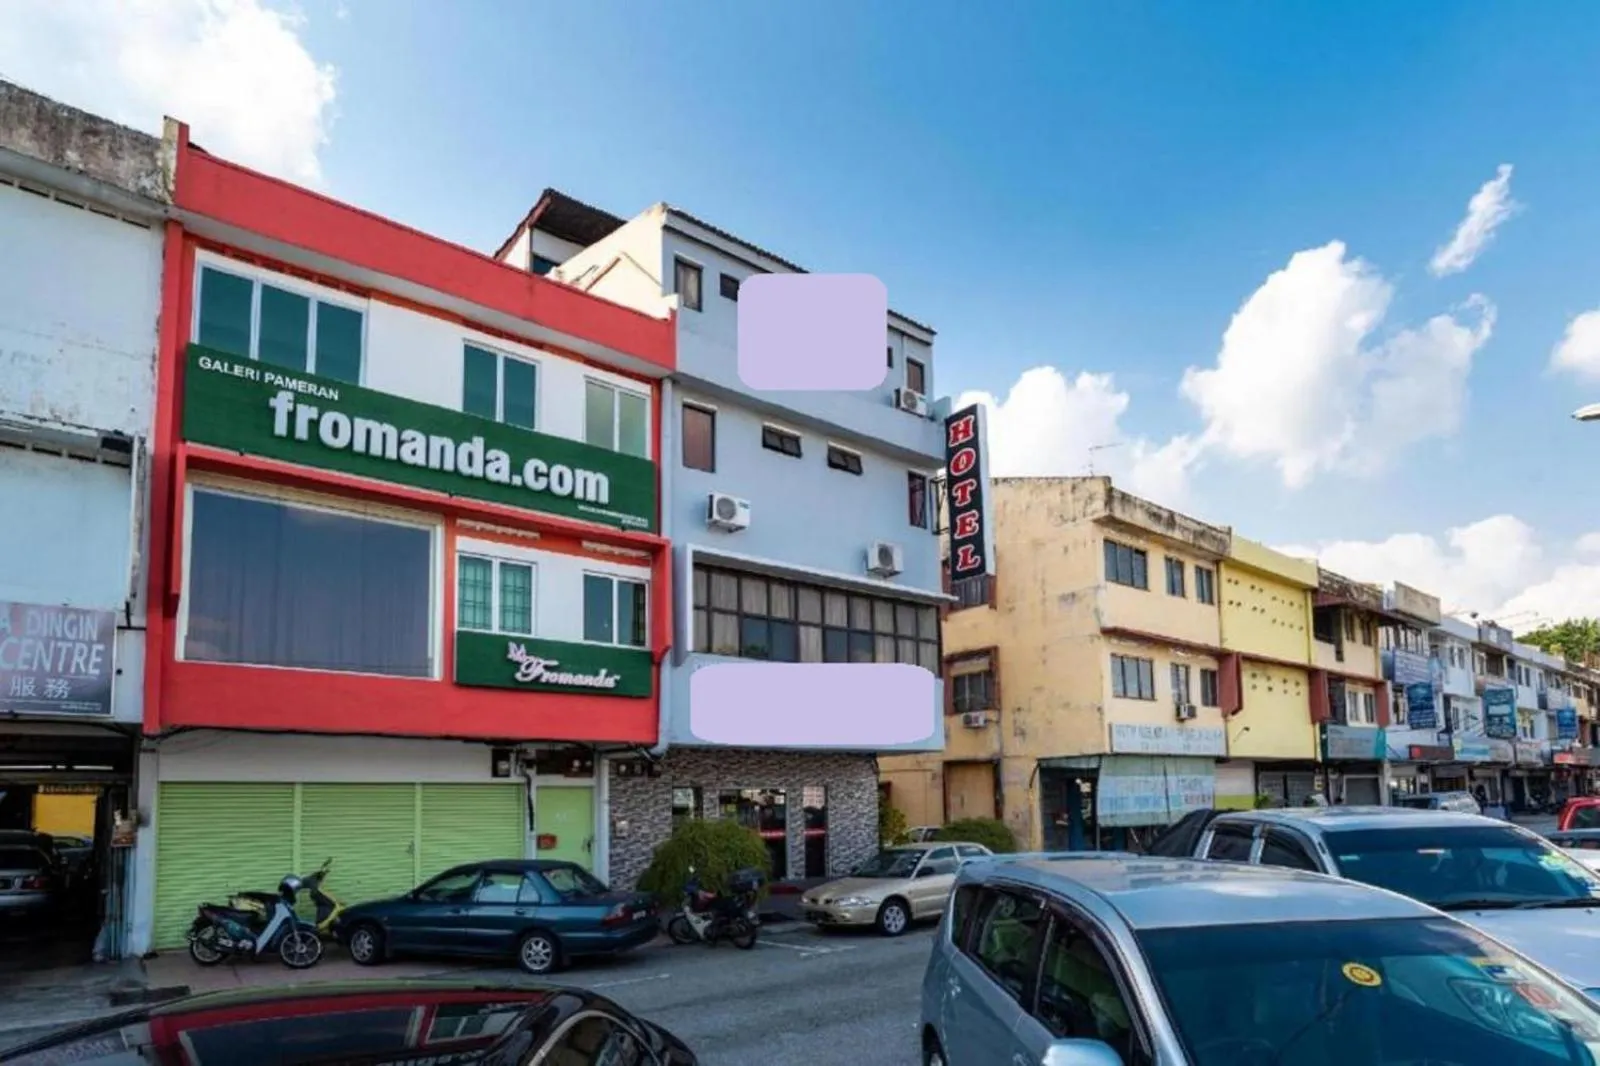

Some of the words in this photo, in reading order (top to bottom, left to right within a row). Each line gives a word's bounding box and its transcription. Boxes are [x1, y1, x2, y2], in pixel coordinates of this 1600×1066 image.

[199, 357, 259, 380] GALERI
[265, 372, 339, 400] PAMERAN
[269, 390, 609, 504] fromanda.com
[949, 415, 981, 571] HOTEL
[26, 611, 98, 641] DINGIN
[0, 636, 105, 674] CENTRE
